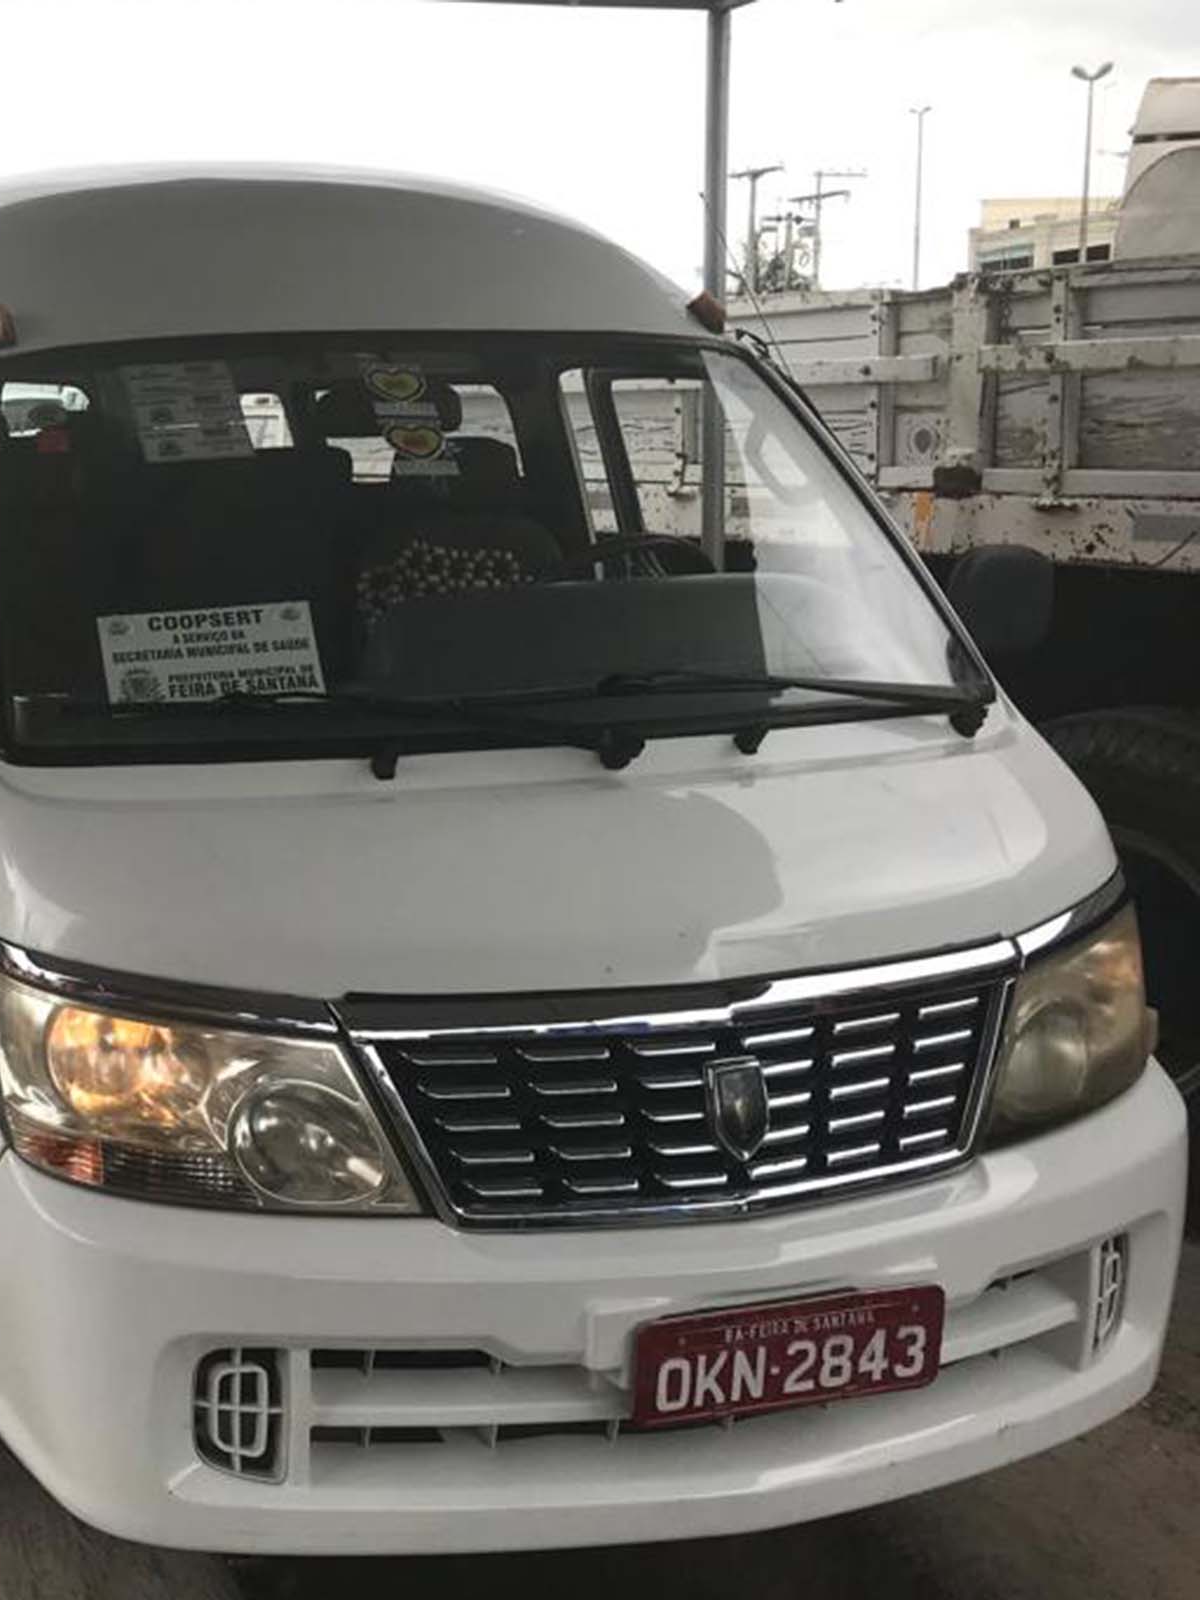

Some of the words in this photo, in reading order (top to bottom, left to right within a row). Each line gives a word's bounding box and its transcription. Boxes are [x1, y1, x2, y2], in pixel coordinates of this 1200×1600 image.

[147, 609, 265, 632] COOPSERT
[183, 630, 228, 645] SERVIÇO
[112, 647, 184, 664] SECRETARIA
[186, 643, 251, 658] MUNICIPAL
[253, 640, 270, 653] DE
[168, 670, 236, 683] PREFEITURA
[237, 665, 297, 678] MUNICIPAL
[168, 681, 217, 698] FEIRA
[221, 679, 241, 695] DE
[245, 674, 320, 693] SANTANA
[813, 1310, 875, 1331] SANTANA
[655, 1324, 927, 1414] OKN-2843
